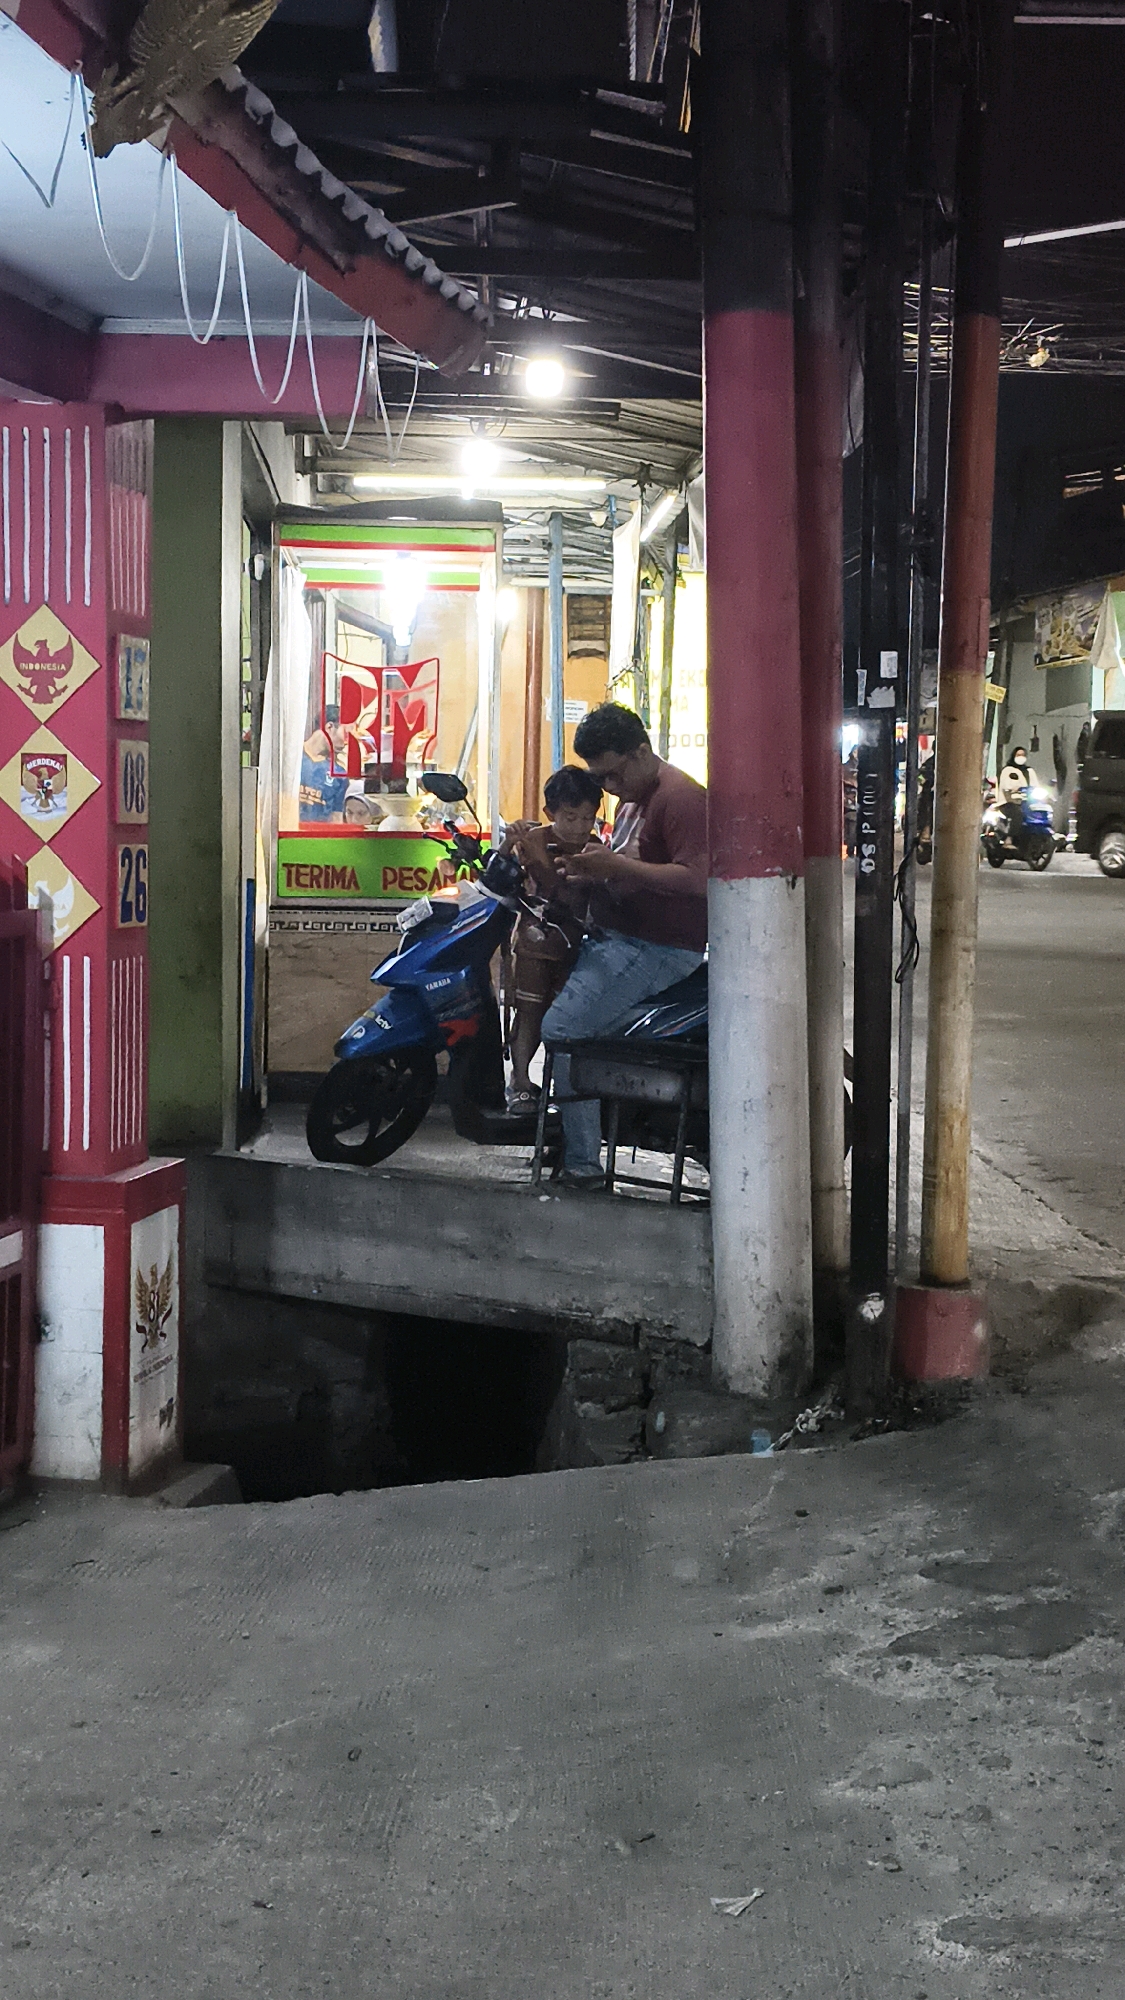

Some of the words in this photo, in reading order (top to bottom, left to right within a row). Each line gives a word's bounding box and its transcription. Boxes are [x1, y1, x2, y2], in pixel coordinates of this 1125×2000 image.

[19, 662, 66, 671] INDONESIA
[120, 846, 147, 924] 26
[282, 862, 360, 891] TERIMA
[425, 977, 451, 991] YAMAHA
